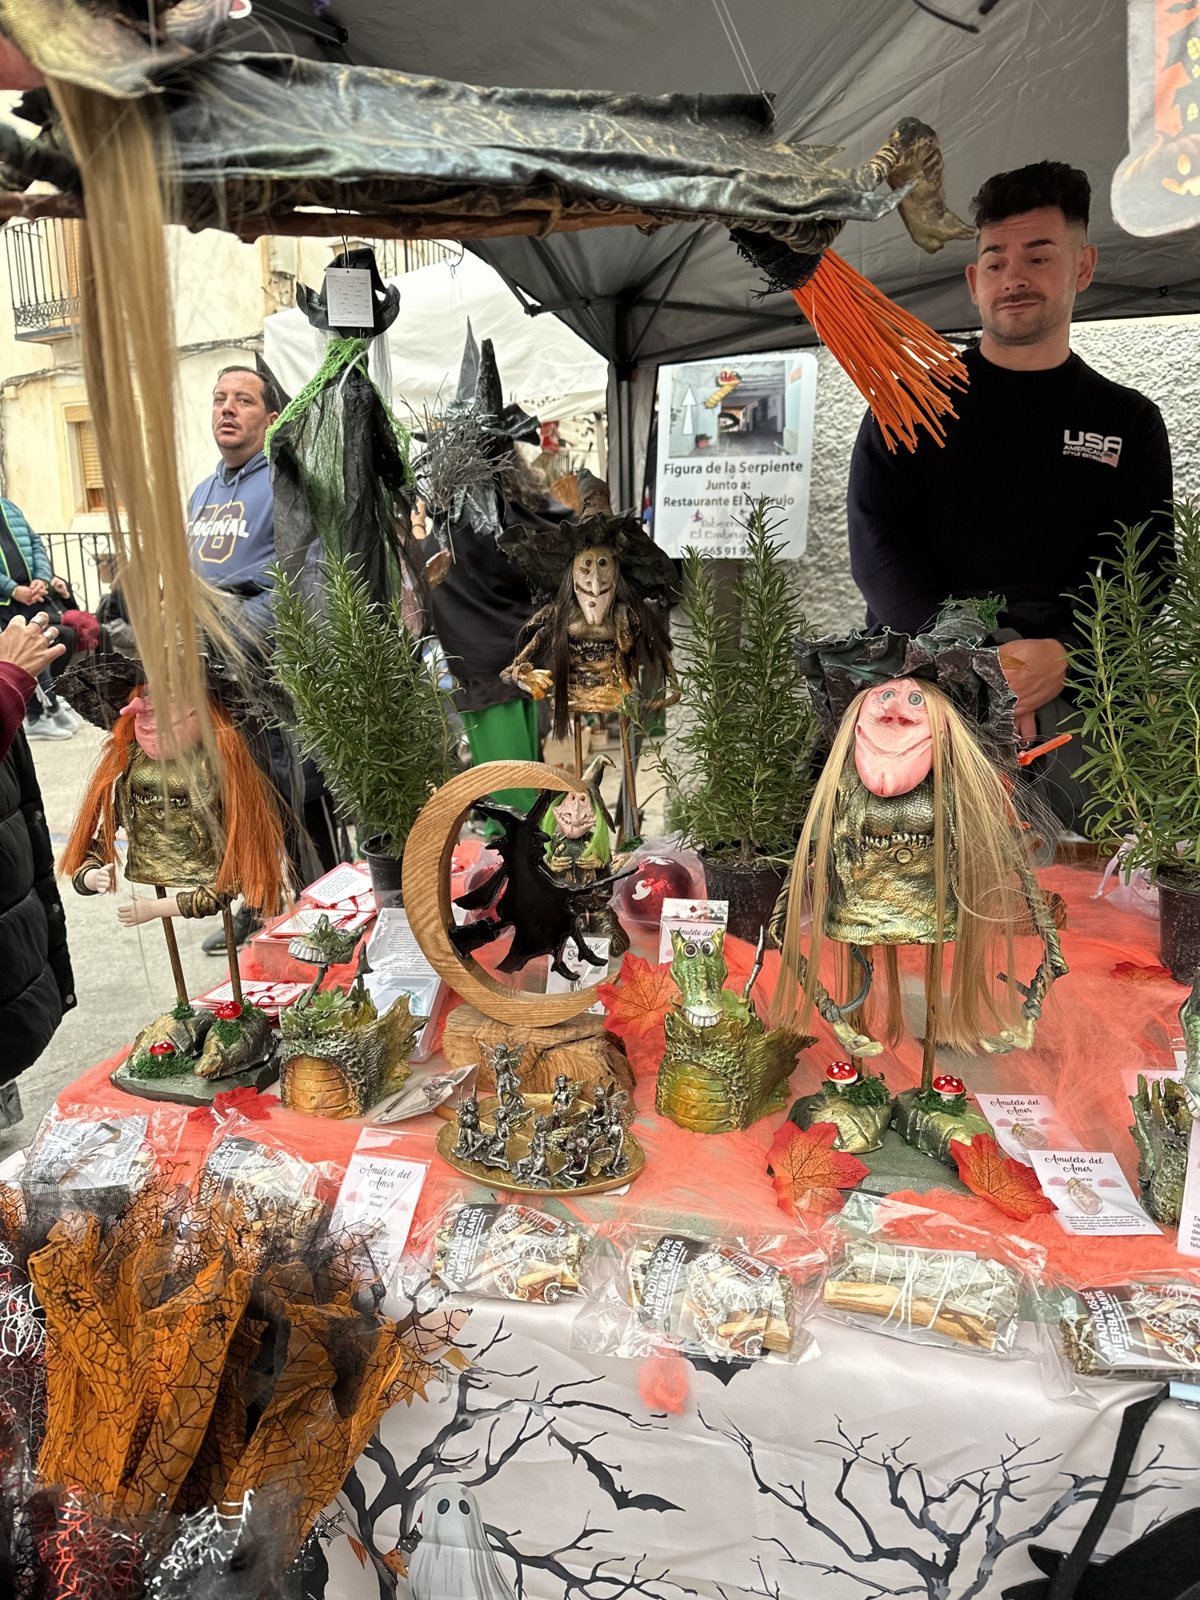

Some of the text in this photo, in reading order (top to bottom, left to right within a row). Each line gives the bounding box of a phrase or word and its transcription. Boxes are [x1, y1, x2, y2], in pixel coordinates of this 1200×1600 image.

[1063, 429, 1122, 455] USA
[664, 460, 803, 477] Figura de la Serpiente
[706, 480, 751, 490] Junto a:
[664, 496, 730, 507] Restaurante
[732, 496, 742, 506] El
[990, 1098, 1026, 1109] Amuleto
[1006, 1106, 1033, 1116] Amor
[217, 1140, 232, 1154] DE
[1044, 1154, 1104, 1166] Amuleto del
[359, 1163, 412, 1180] Amuleto del
[1062, 1163, 1093, 1175] Amor
[368, 1177, 395, 1190] Amor
[454, 1239, 472, 1283] HIERBA
[465, 1207, 482, 1237] SANTA
[643, 1238, 674, 1315] ATADILLOS DE
[652, 1272, 671, 1320] HIERBA
[665, 1240, 684, 1271] SANTA
[1094, 1290, 1112, 1311] SANTA
[1087, 1300, 1114, 1360] ATADILLOS
[1104, 1313, 1126, 1358] HIERBA
